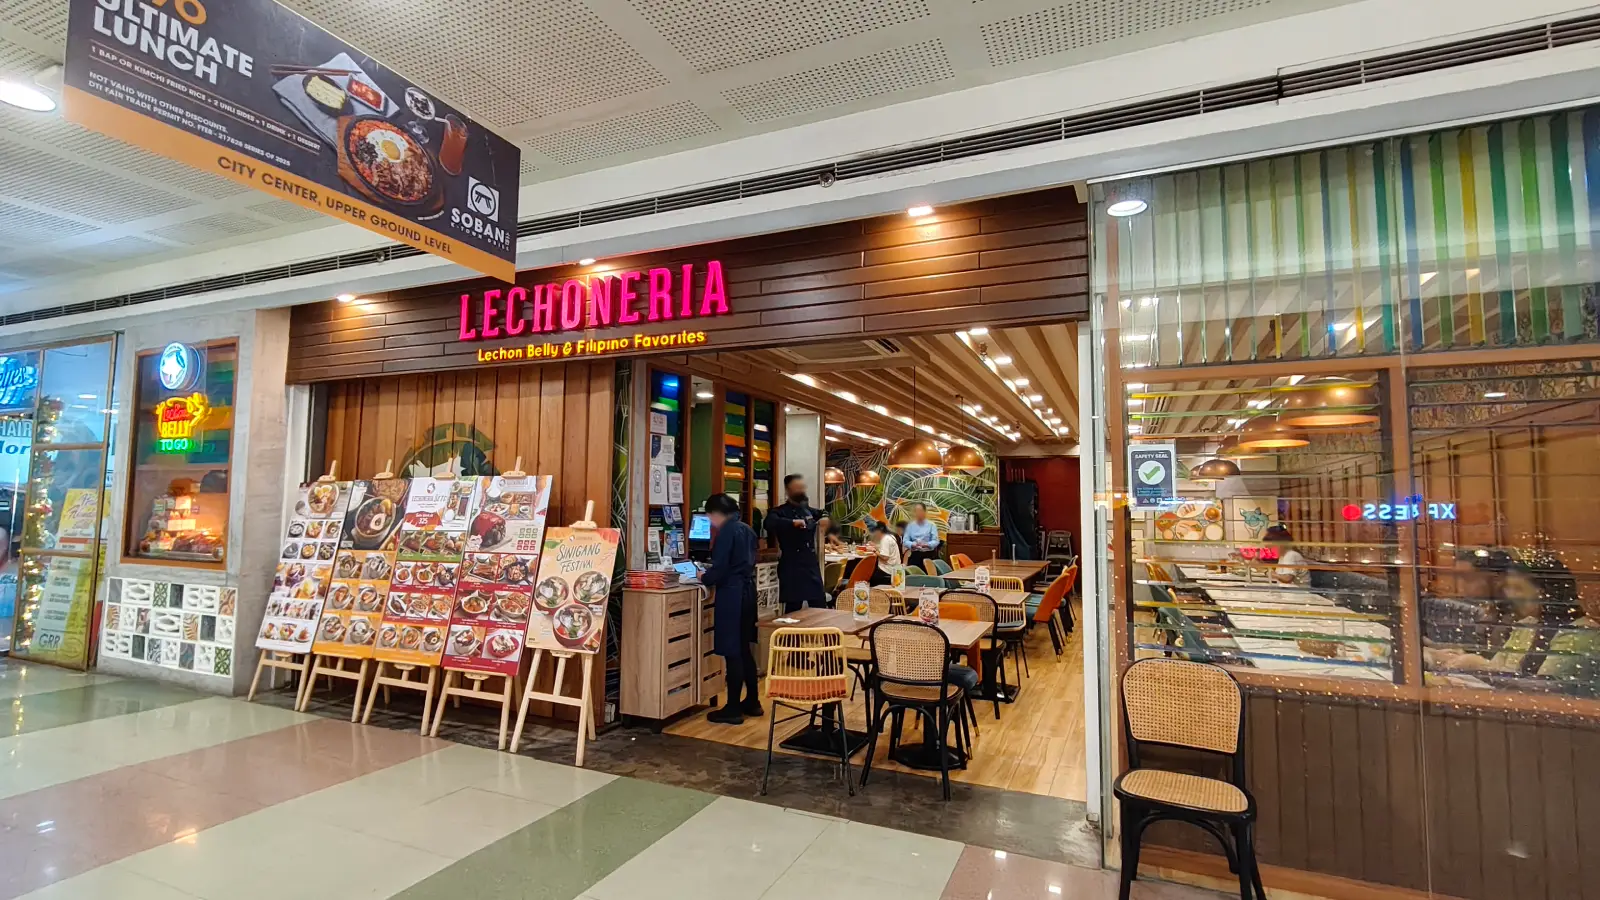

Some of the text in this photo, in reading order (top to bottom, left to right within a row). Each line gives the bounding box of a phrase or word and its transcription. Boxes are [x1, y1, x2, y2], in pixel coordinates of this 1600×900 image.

[93, 6, 218, 85] LUNCH
[96, 0, 254, 78] ULTIMATE
[88, 80, 103, 91] DTI
[104, 87, 124, 99] FAIR
[125, 95, 152, 111] TRADE
[153, 106, 181, 122] PERMIT
[181, 118, 196, 128] NO.
[244, 143, 265, 156] SERIES
[265, 152, 275, 160] OF
[89, 71, 228, 134] NOT VALID WITH OTHER DISCOUNTS.
[99, 49, 118, 61] BAP
[119, 58, 132, 68] OR
[134, 64, 165, 83] KIMCHI
[166, 78, 187, 93] FRIED
[189, 89, 206, 101] RICE
[219, 102, 236, 114] UNLI
[236, 109, 255, 122] SIDES
[266, 123, 286, 136] DRINK
[297, 135, 321, 150] DESSERT
[217, 155, 256, 180] CITY
[261, 172, 322, 206] CENTER,
[326, 196, 366, 221] UPPER
[370, 215, 421, 242] GROUND
[424, 235, 453, 255] LEVEL
[451, 207, 505, 243] SOBAN
[458, 260, 730, 342] LECHONERIA
[478, 331, 705, 362] Lechon Belly & Filipino Favorites
[159, 438, 173, 451] TO
[161, 420, 190, 438] BELLY
[556, 542, 601, 561] SINIGANG
